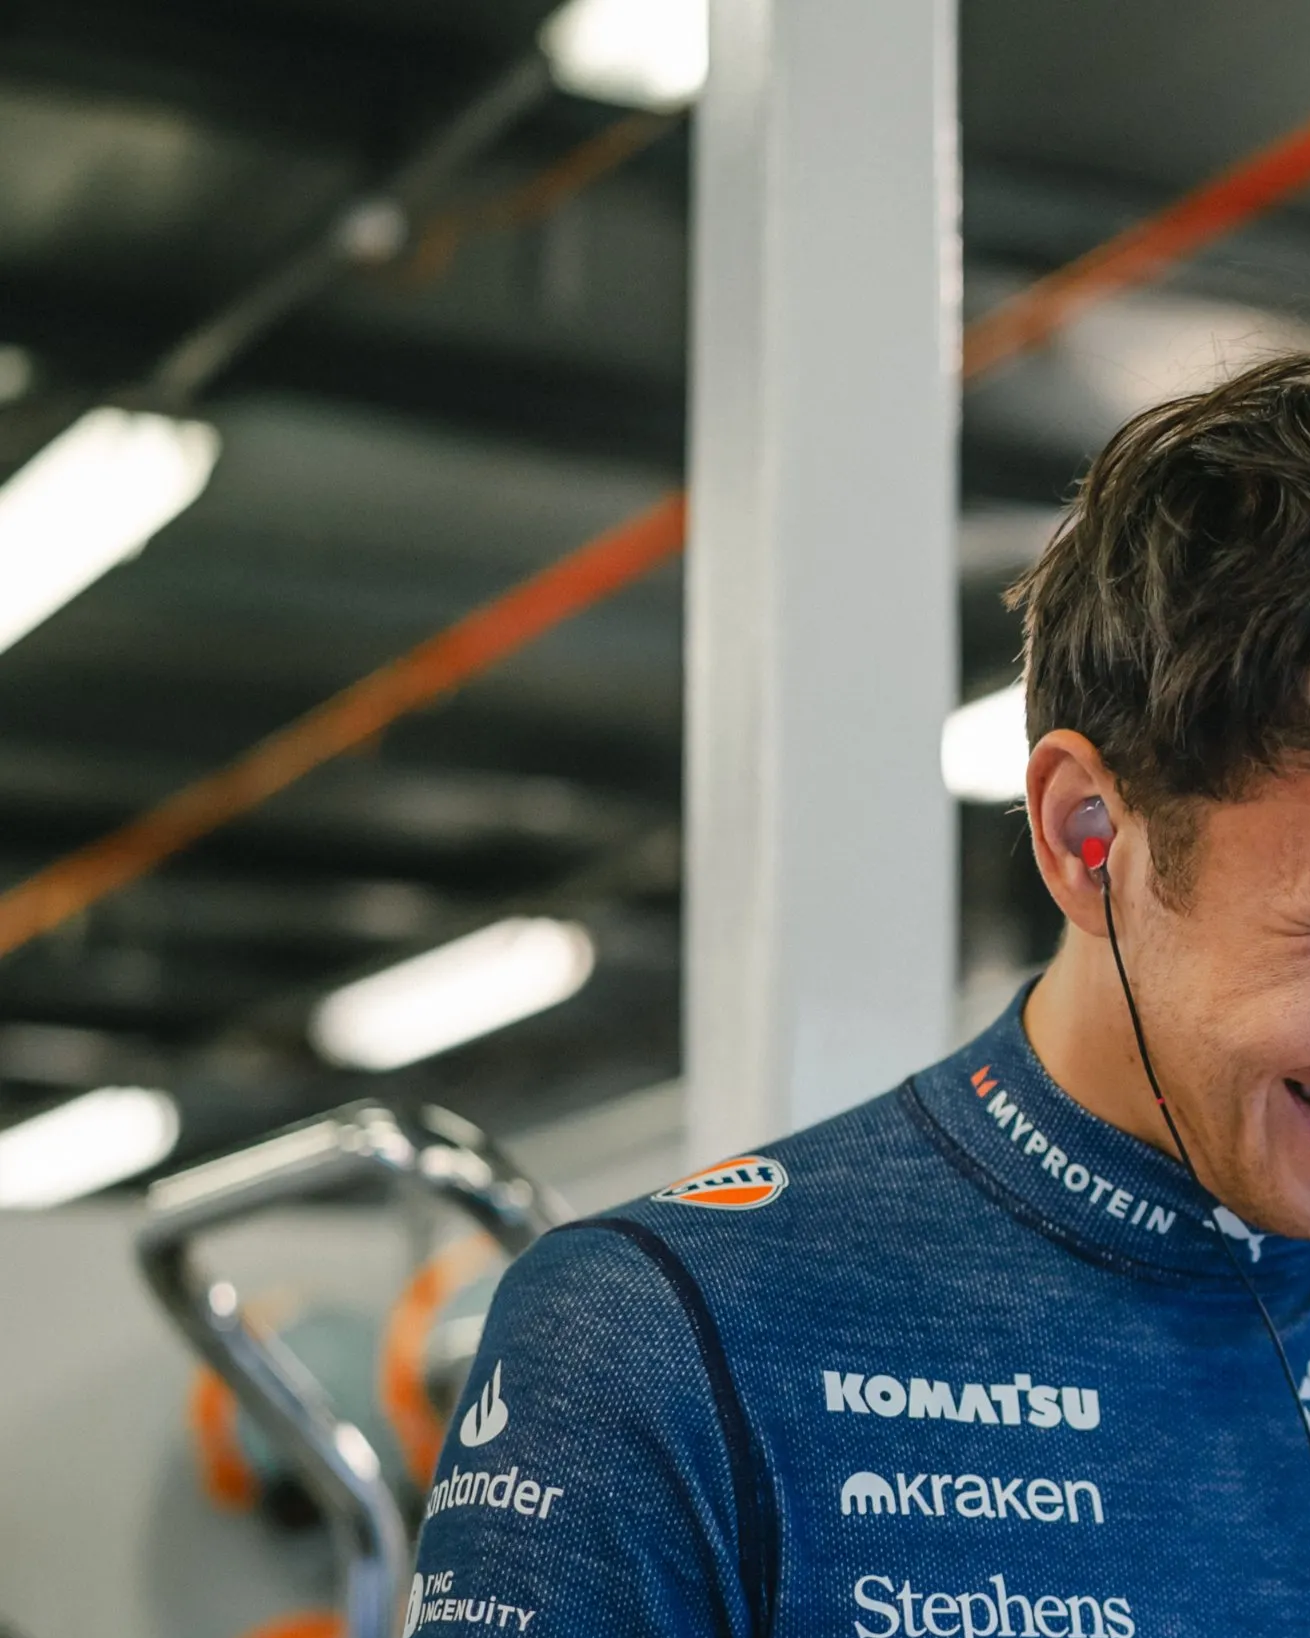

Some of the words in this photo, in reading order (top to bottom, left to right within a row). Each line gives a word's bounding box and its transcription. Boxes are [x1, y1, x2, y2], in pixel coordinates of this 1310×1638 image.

[986, 1089, 1176, 1234] MYPROTEIN
[823, 1370, 1101, 1431] KOMATSU
[425, 1464, 564, 1520] antander
